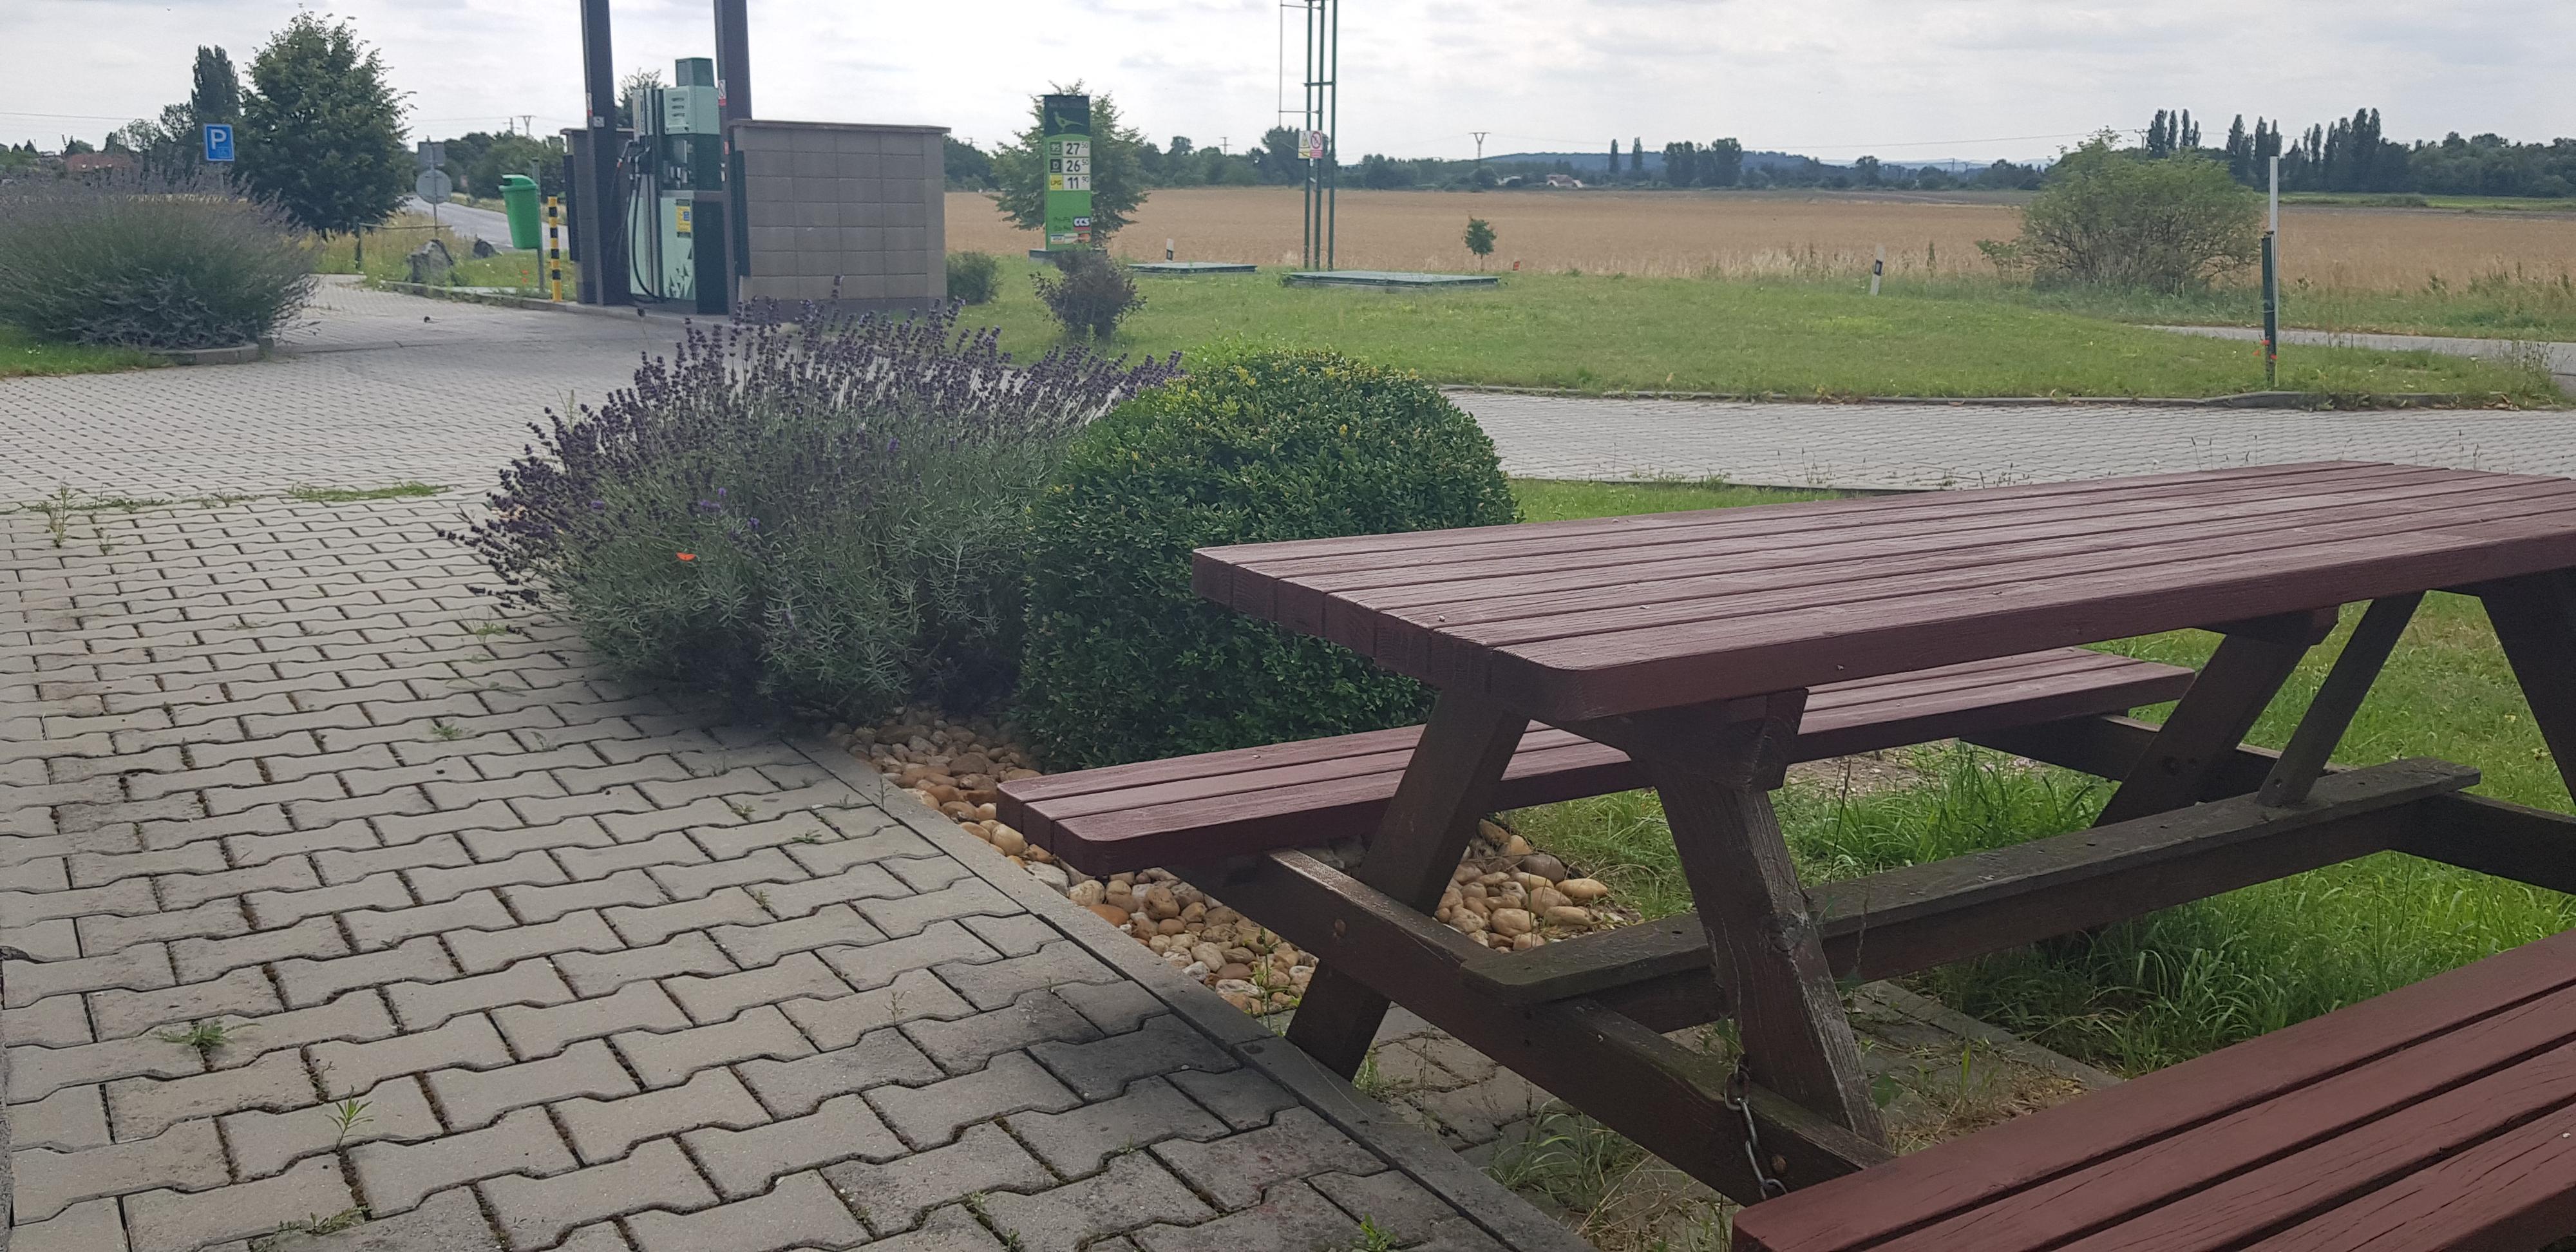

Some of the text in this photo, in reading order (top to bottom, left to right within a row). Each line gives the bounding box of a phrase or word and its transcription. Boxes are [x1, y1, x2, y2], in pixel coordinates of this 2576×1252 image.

[211, 129, 227, 149] P
[1066, 143, 1080, 155] 27
[1066, 160, 1081, 172] 26
[1067, 176, 1079, 189] 11
[1074, 218, 1090, 226] CCS
